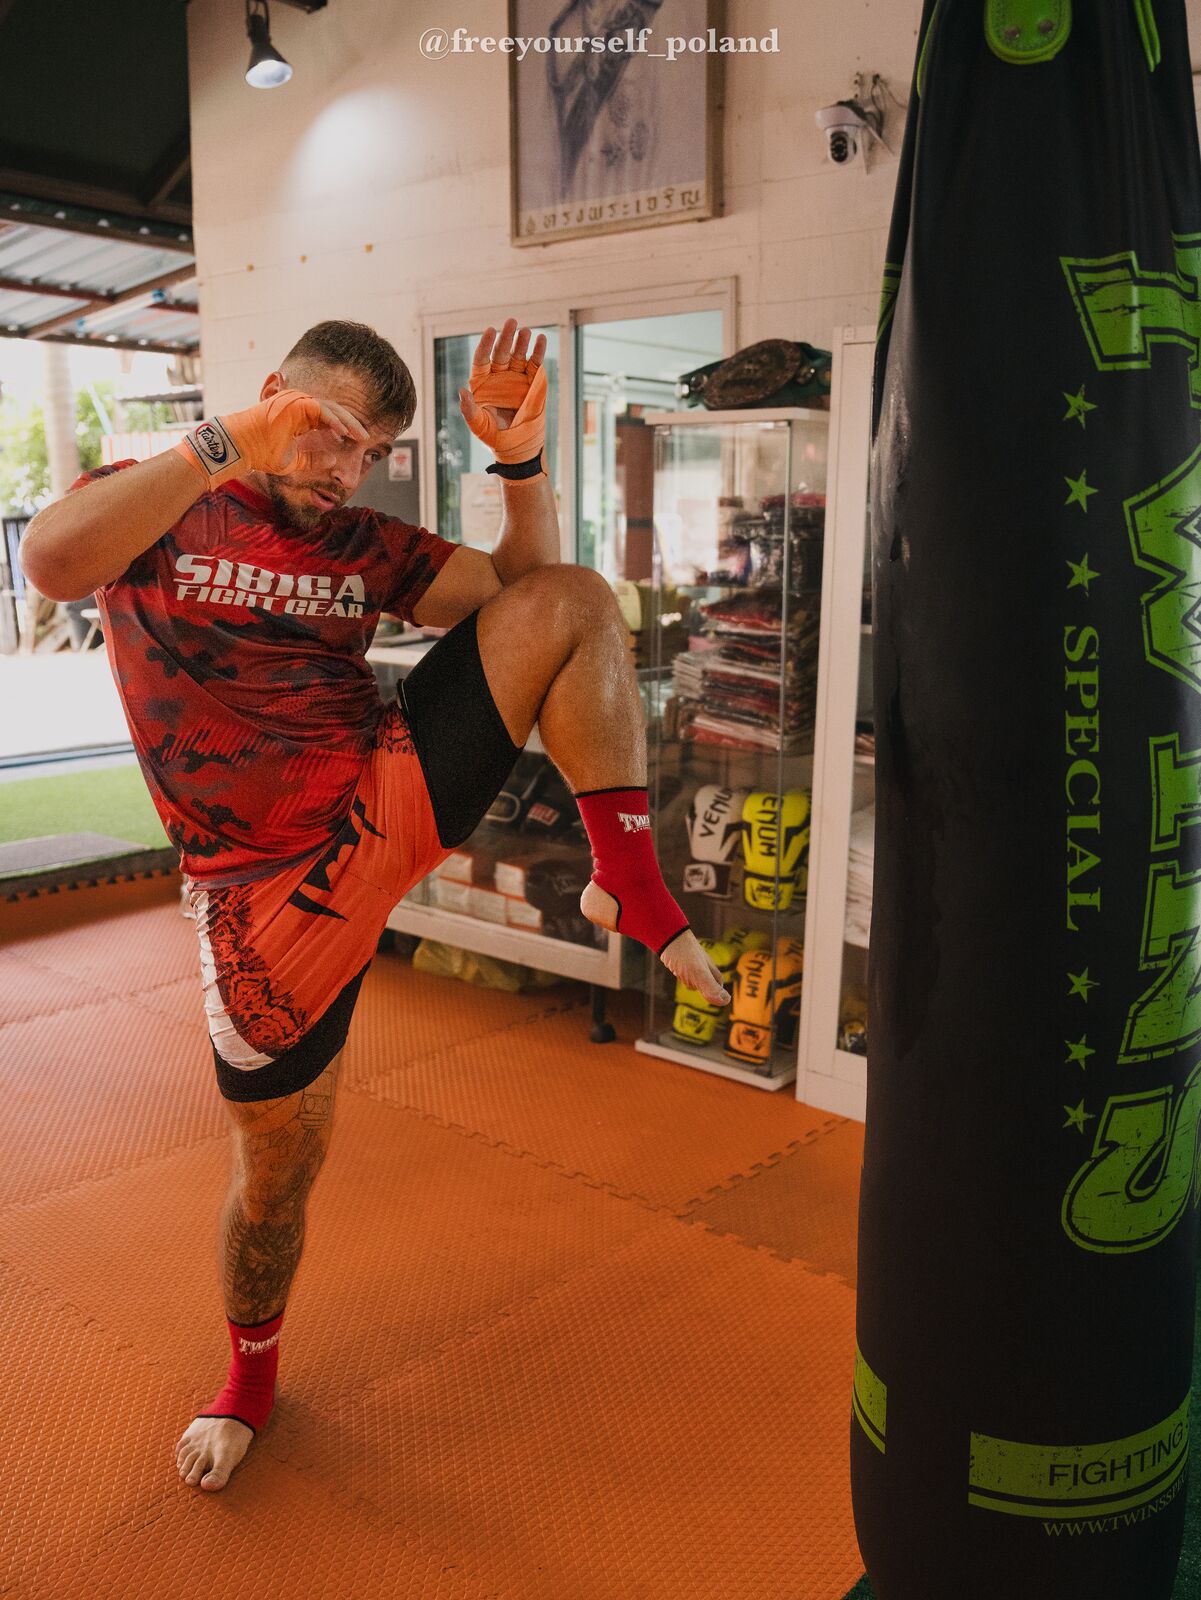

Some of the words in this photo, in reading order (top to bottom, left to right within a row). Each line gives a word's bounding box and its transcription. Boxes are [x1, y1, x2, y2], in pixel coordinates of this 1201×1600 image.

[198, 426, 223, 457] Fairtex
[174, 554, 366, 602] SIBIGA
[177, 585, 280, 611] FIGHT
[284, 599, 364, 618] GEAR
[1063, 625, 1101, 932] SPECIAL
[699, 786, 733, 837] VENU
[757, 795, 779, 857] ENUM
[1049, 1422, 1183, 1487] FIGHTING
